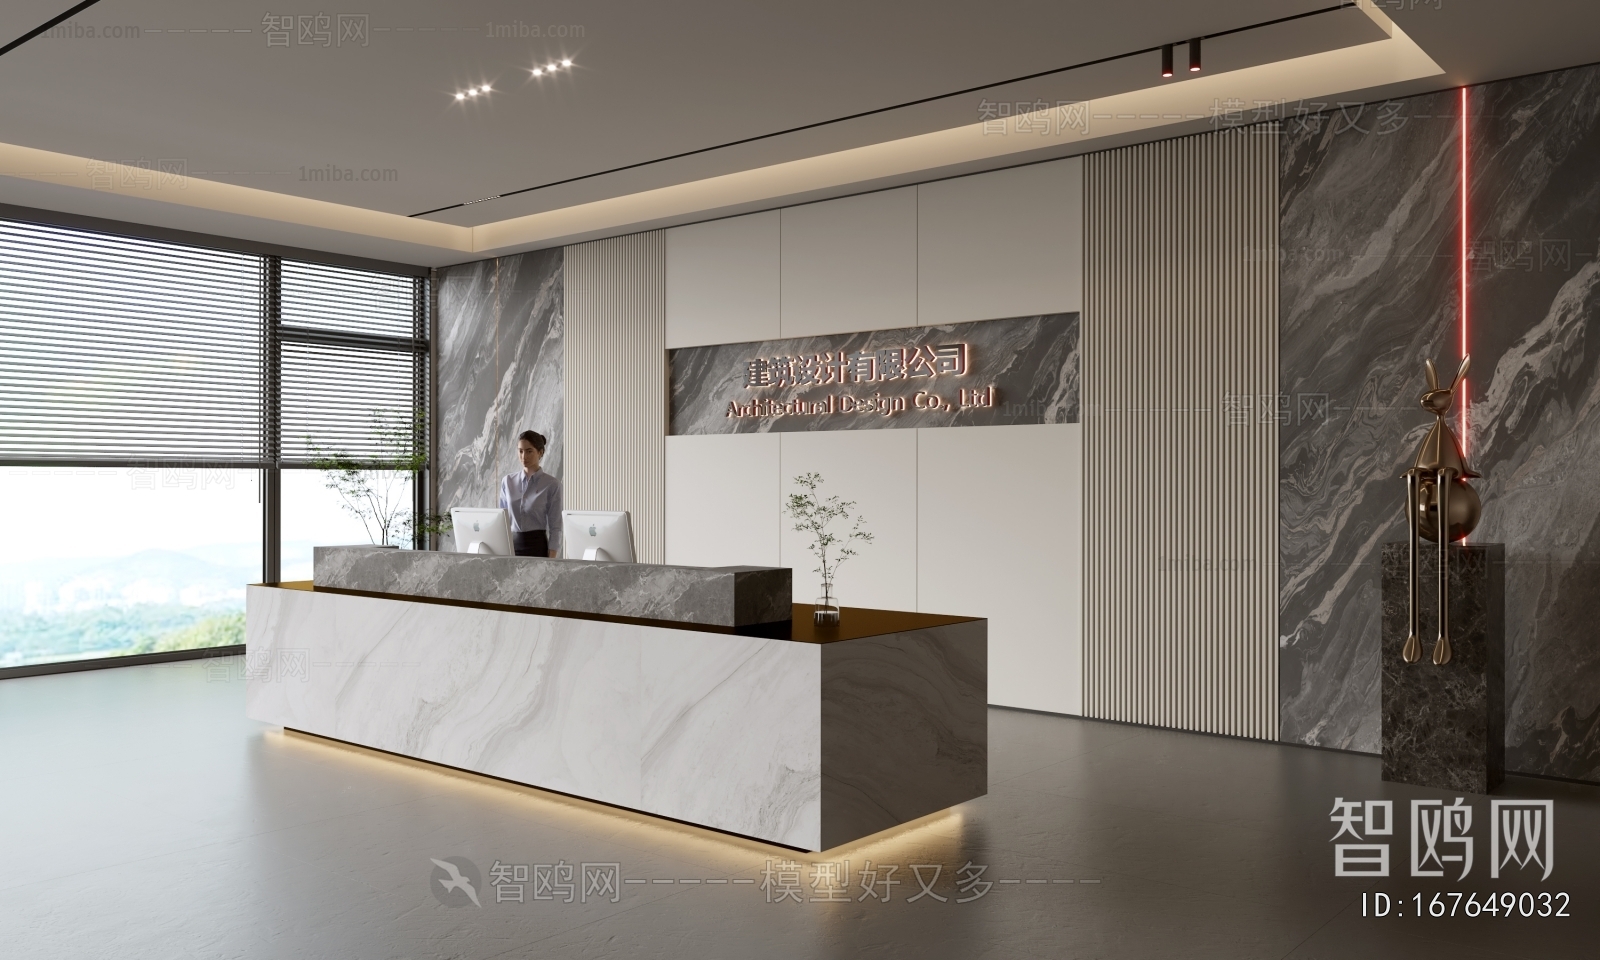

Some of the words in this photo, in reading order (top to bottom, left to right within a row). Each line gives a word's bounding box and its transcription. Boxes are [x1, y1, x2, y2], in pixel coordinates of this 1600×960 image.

[743, 343, 968, 389] 建筑设计有限公司
[726, 395, 834, 418] Architectural
[839, 392, 905, 416] Design
[959, 386, 993, 408] Ltd
